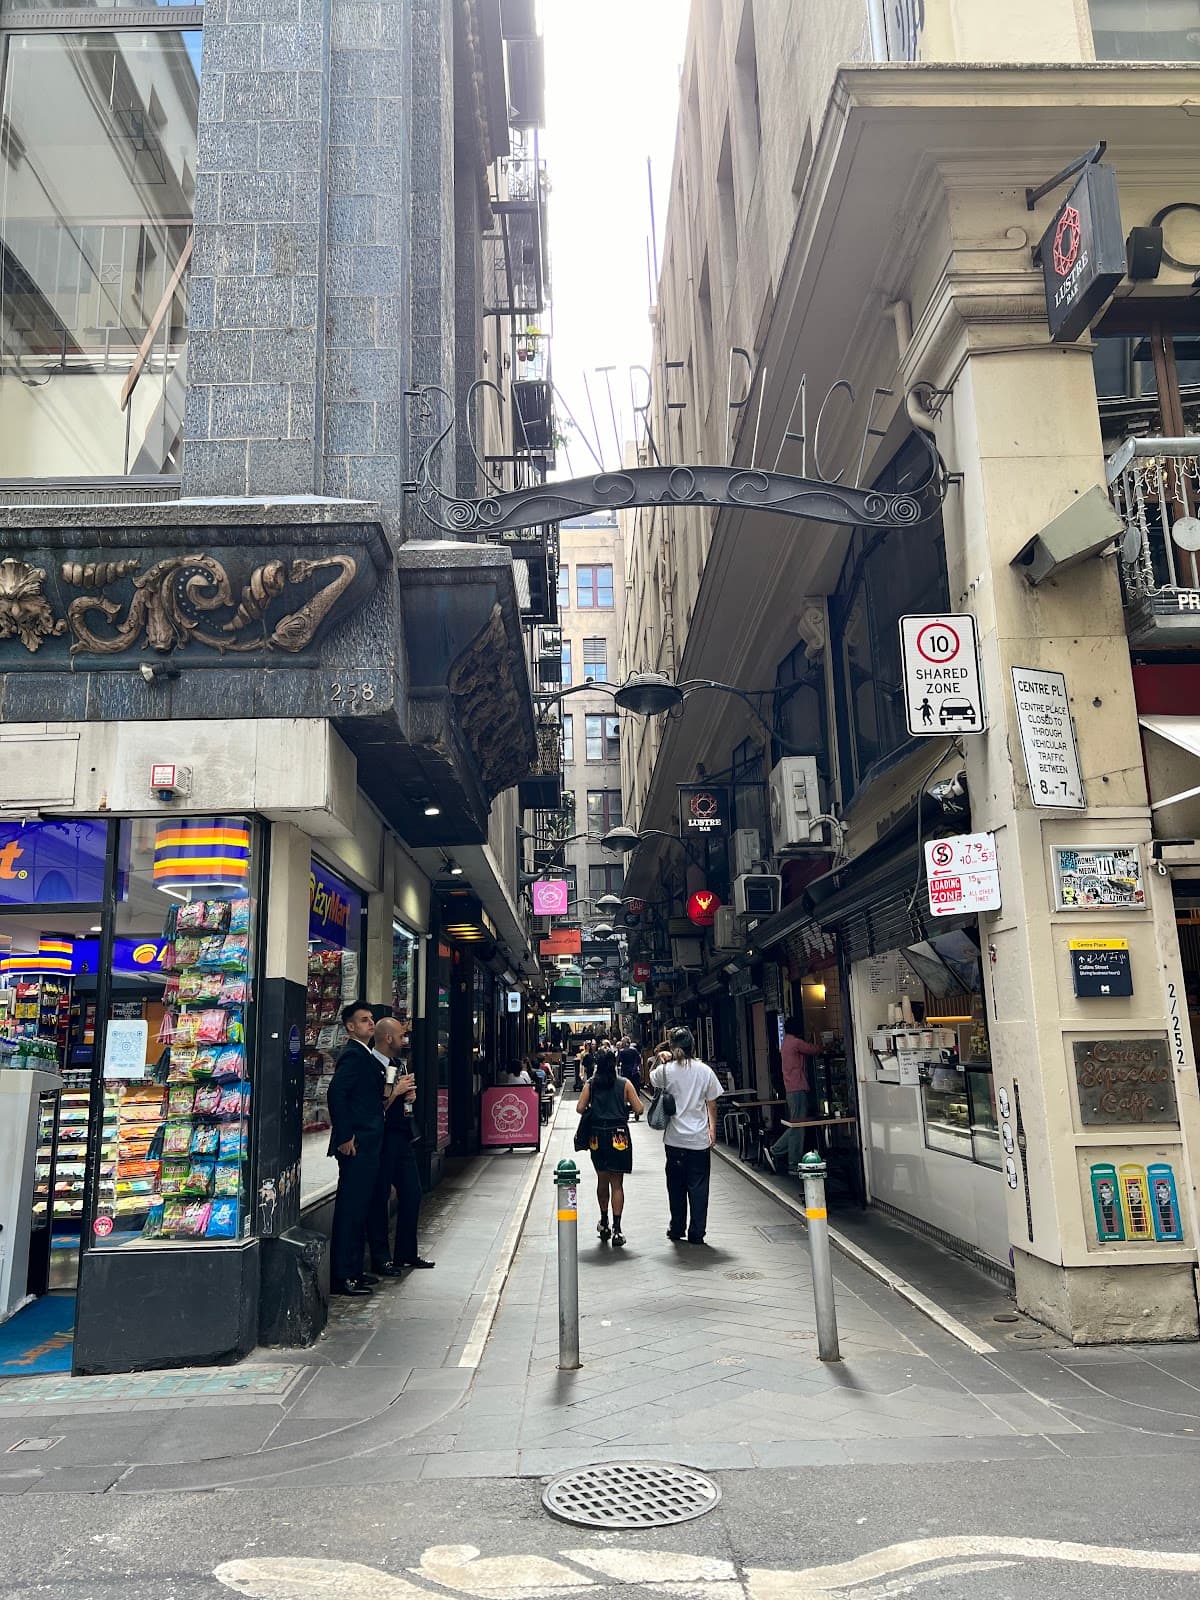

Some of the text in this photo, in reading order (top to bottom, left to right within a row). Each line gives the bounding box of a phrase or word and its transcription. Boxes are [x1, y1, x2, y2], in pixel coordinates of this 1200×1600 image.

[1054, 251, 1089, 308] LUSTRE
[1066, 286, 1079, 305] BAR
[726, 347, 894, 488] PLACE
[930, 636, 949, 653] 10
[916, 668, 968, 680] SHARED
[331, 682, 374, 701] 258
[926, 683, 960, 694] ZONE
[1018, 681, 1062, 696] CENTRE PL
[1020, 702, 1067, 715] CENTRE PLACE
[1028, 714, 1062, 726] CLOSED TO
[1032, 727, 1062, 738] THROUGH
[1032, 740, 1067, 751] VEHICULAR
[1038, 752, 1065, 762] TRAFFIC
[1039, 764, 1068, 774] BETWEEN
[688, 818, 721, 826] LUSTRE
[931, 879, 960, 890] LOADING
[931, 891, 961, 903] ZONE
[978, 888, 994, 896] OTHER
[1168, 984, 1185, 1065] 2/252
